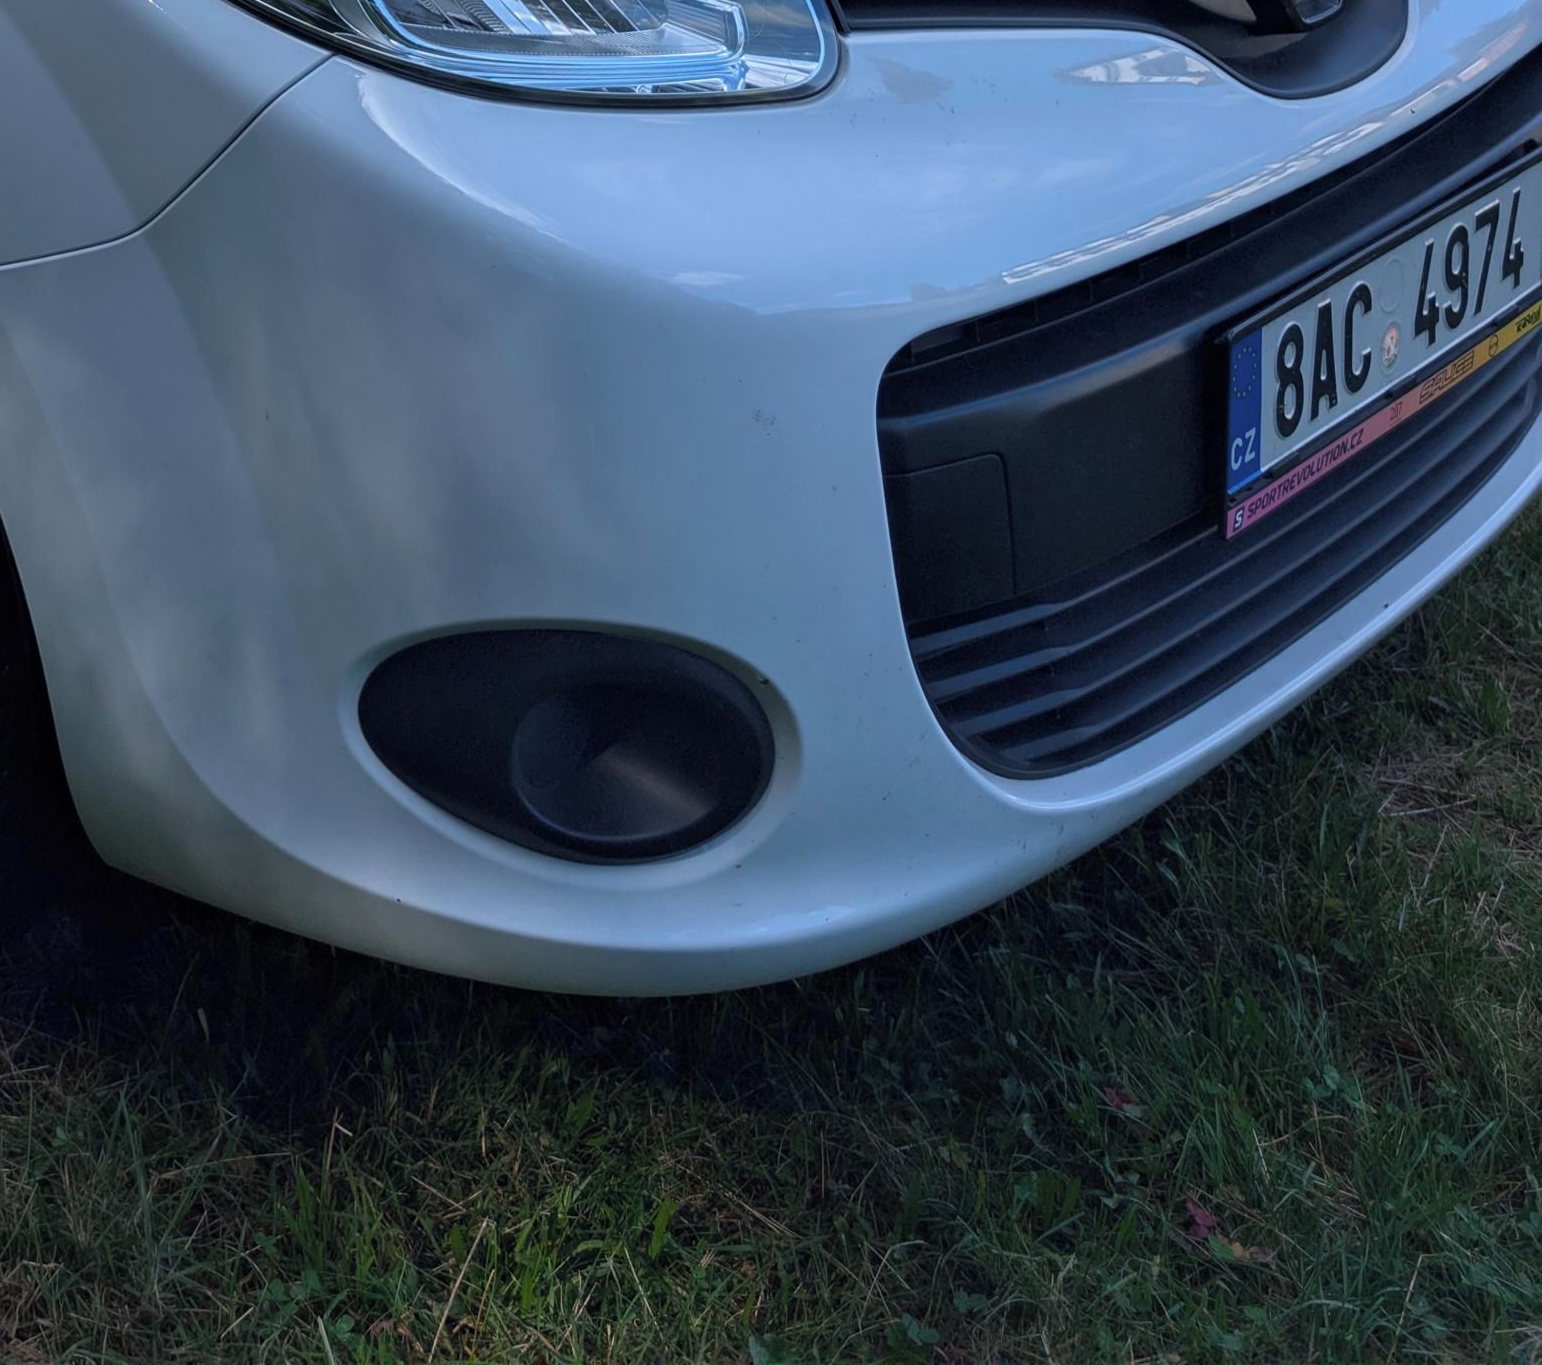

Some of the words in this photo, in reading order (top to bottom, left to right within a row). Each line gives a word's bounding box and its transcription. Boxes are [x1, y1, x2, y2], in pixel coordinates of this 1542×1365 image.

[1275, 280, 1373, 439] 8AC
[1413, 187, 1525, 348] 4974
[1230, 426, 1257, 471] CZ
[1247, 428, 1365, 519] SPORTREVOLUTION.CZ
